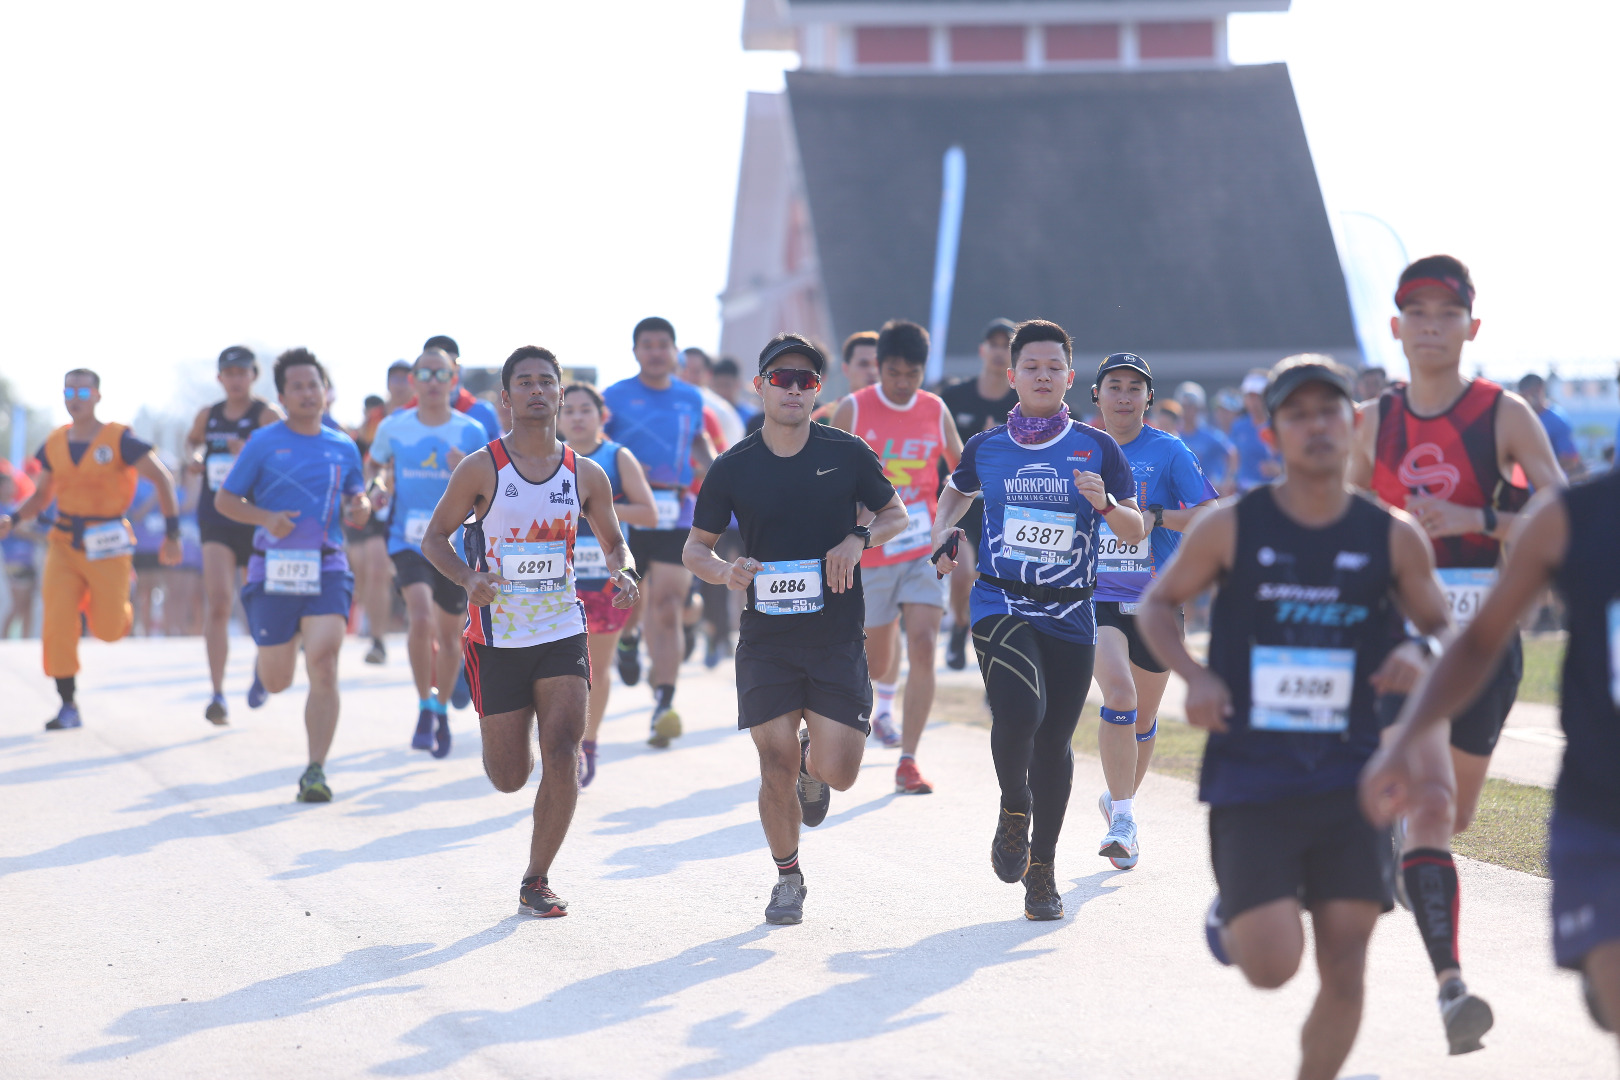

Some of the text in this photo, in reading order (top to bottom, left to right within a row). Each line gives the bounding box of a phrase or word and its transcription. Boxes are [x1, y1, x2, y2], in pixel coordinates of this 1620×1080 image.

[881, 439, 938, 460] LET
[1004, 478, 1070, 493] WORKPOINT
[1140, 481, 1148, 512] SINGHA
[1016, 525, 1065, 546] 6387
[277, 563, 310, 578] 6193
[517, 560, 552, 574] 6291
[769, 579, 806, 594] 6286
